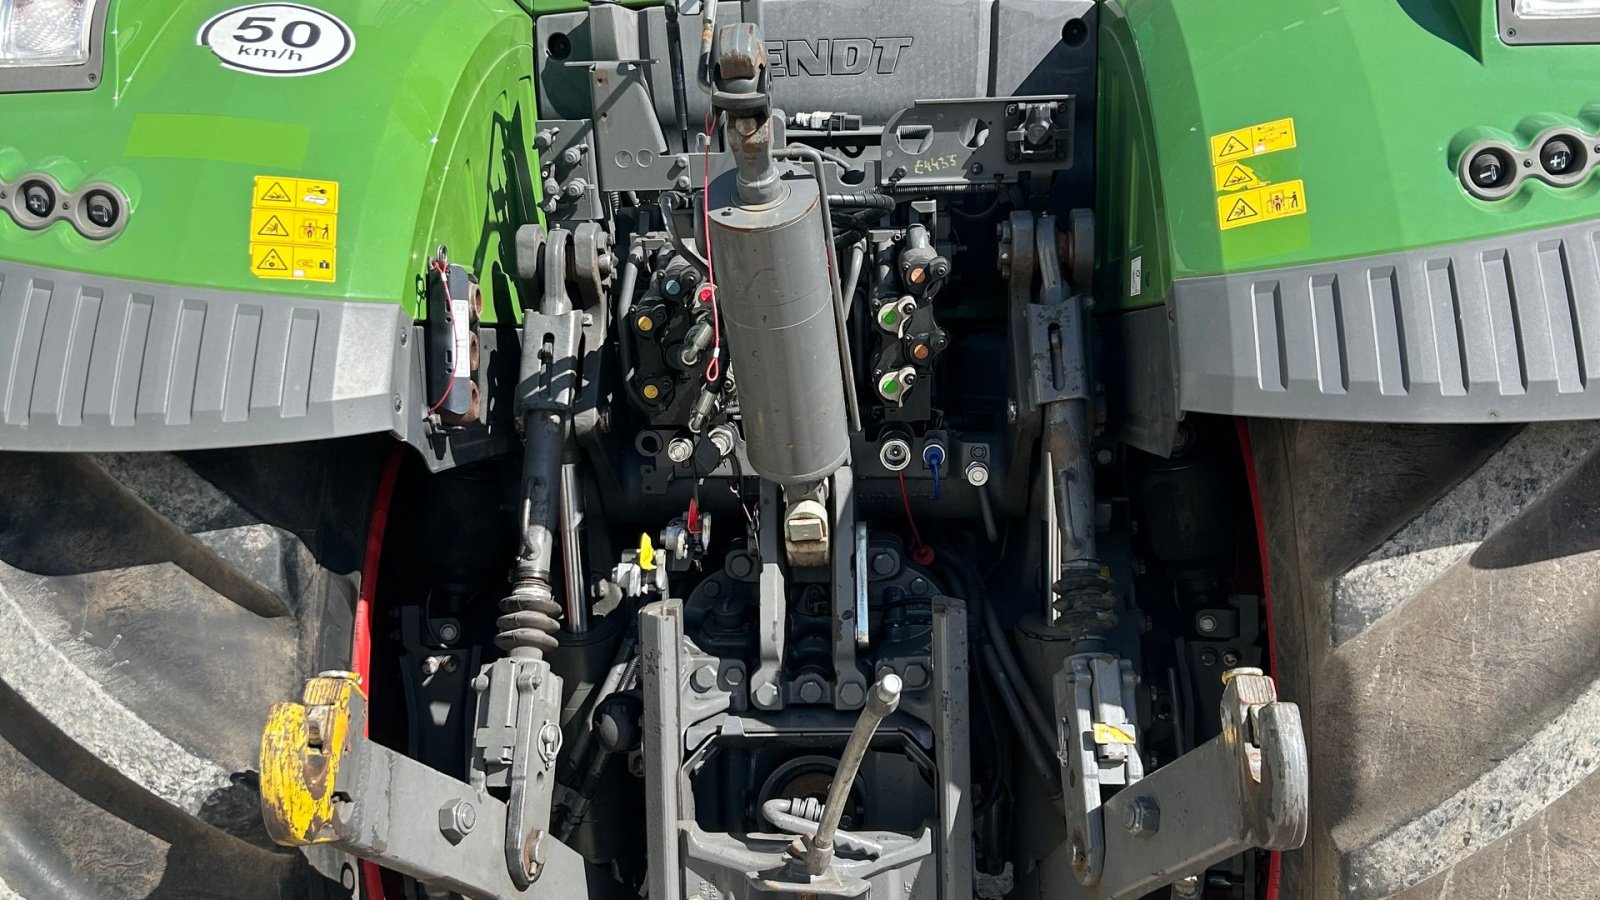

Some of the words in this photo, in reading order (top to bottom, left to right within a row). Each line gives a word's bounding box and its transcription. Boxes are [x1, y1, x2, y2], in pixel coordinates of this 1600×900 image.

[233, 16, 321, 49] 50
[237, 44, 303, 62] km/h
[763, 36, 914, 77] ENDT
